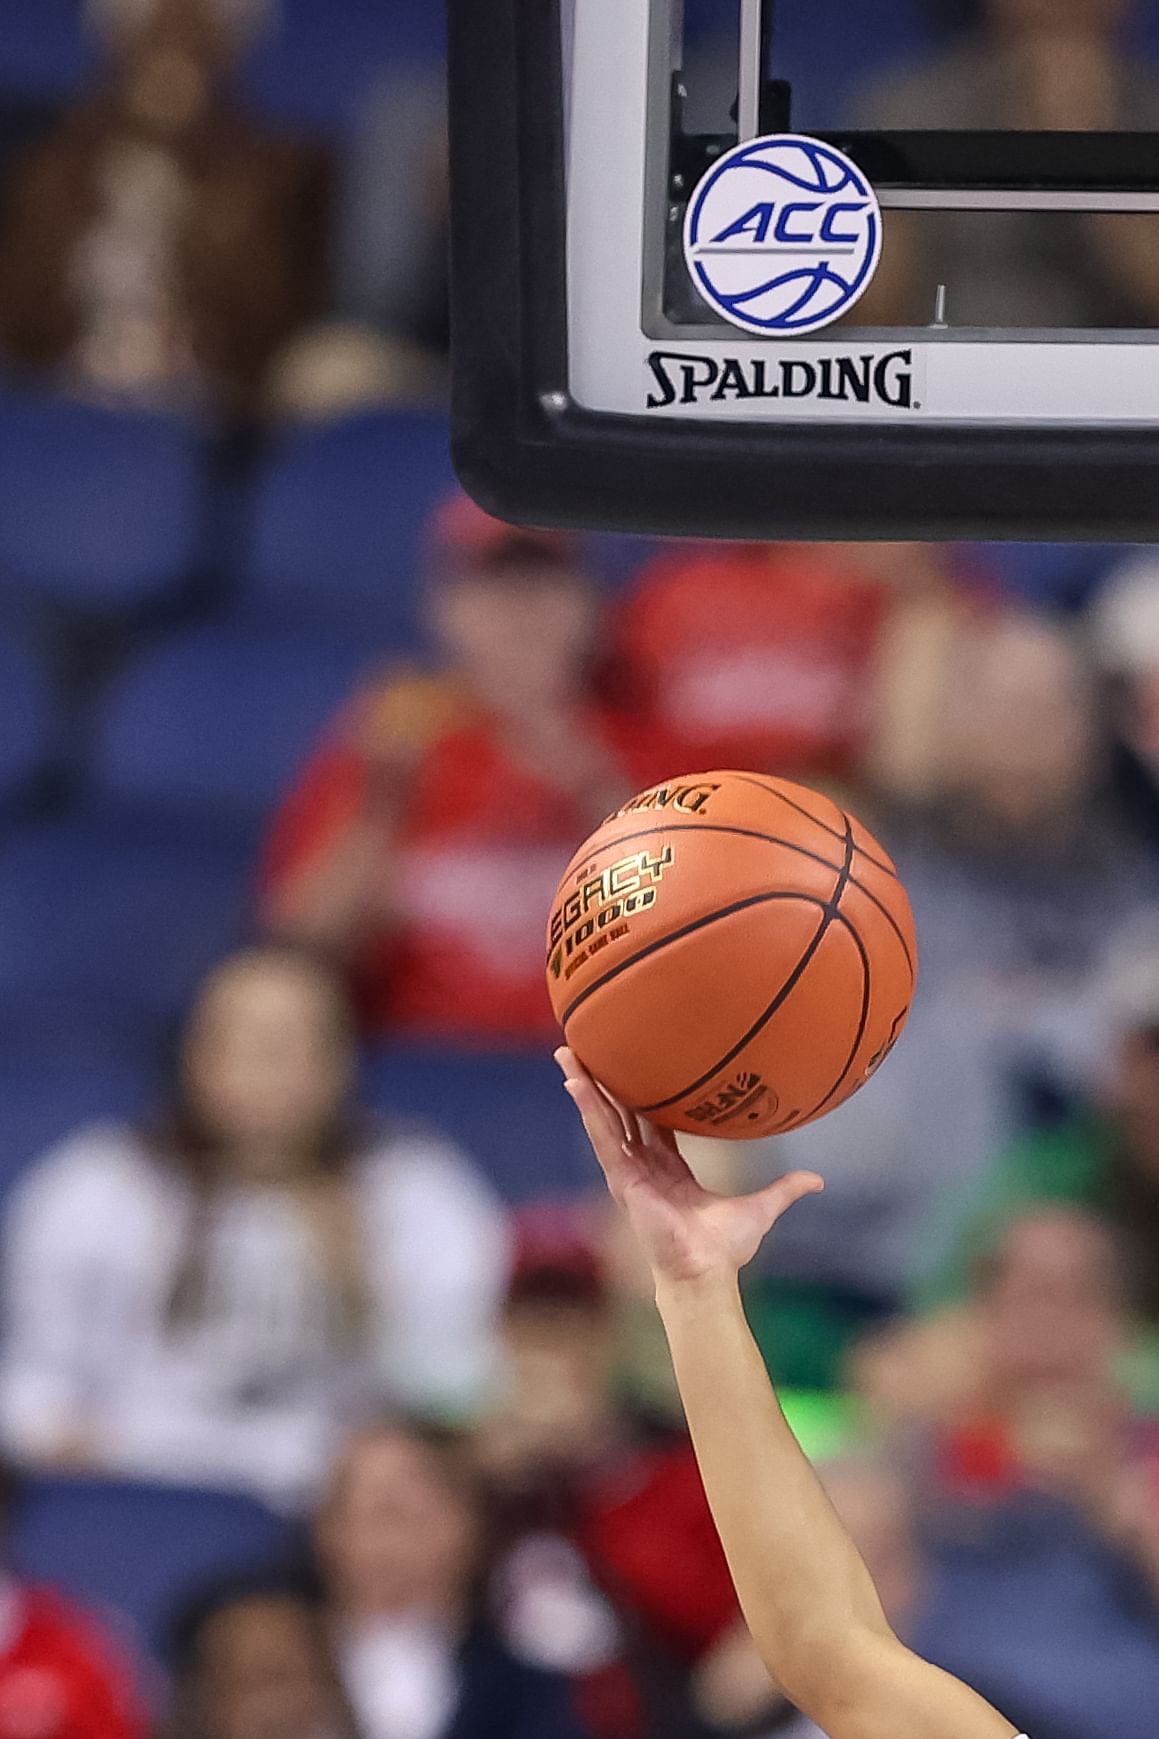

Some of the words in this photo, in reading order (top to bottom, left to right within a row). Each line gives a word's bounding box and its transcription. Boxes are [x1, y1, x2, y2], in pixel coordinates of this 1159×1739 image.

[708, 201, 872, 243] ACC
[646, 348, 914, 410] SPALDING
[546, 843, 675, 967] EGACY
[564, 886, 657, 956] 1000
